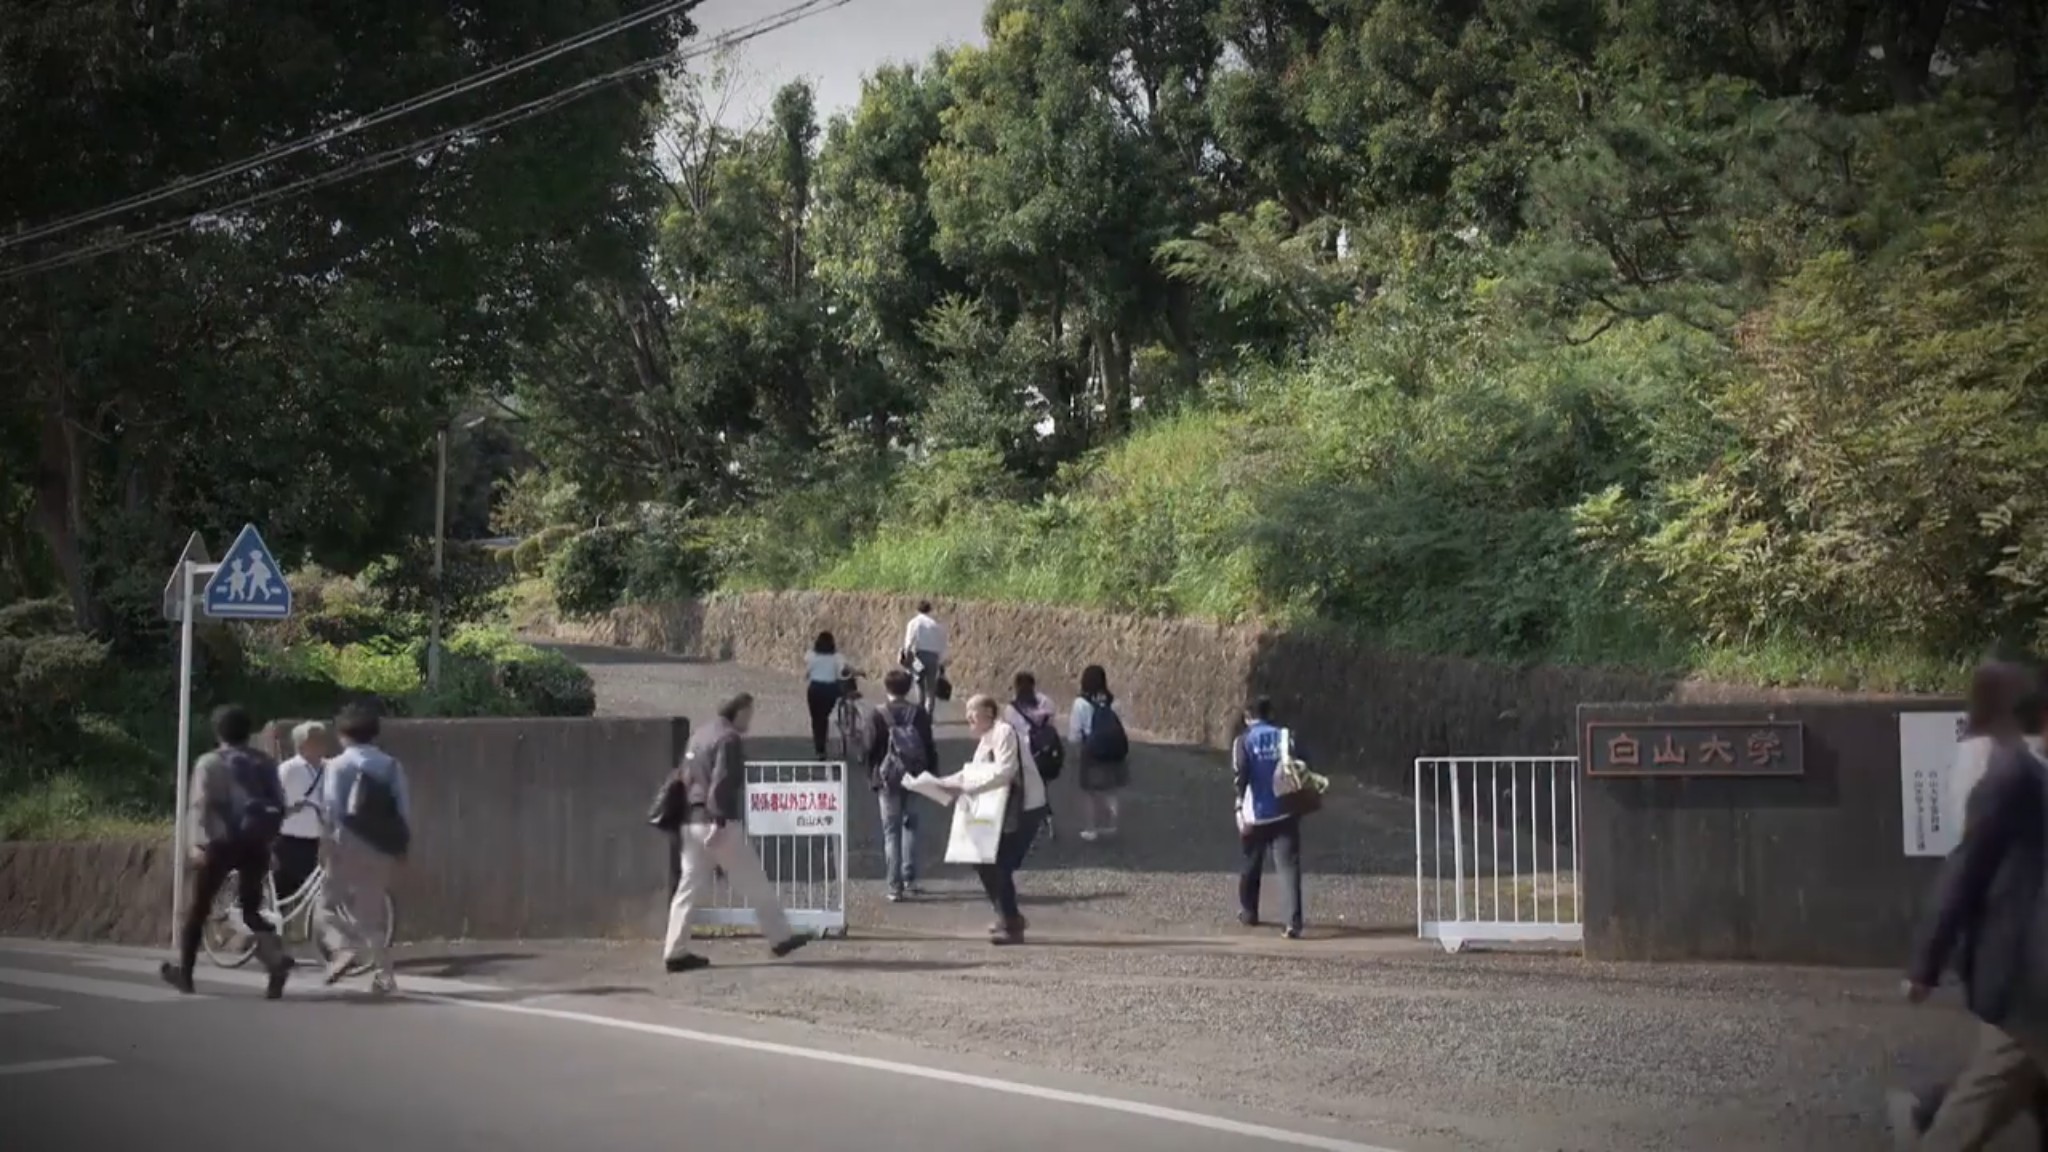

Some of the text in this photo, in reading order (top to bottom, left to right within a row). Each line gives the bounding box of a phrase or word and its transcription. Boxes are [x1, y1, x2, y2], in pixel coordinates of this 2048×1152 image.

[1608, 730, 1781, 765] 白山大学
[751, 793, 837, 811] 関係者以外立入禁止
[796, 815, 834, 826] 白山大学
